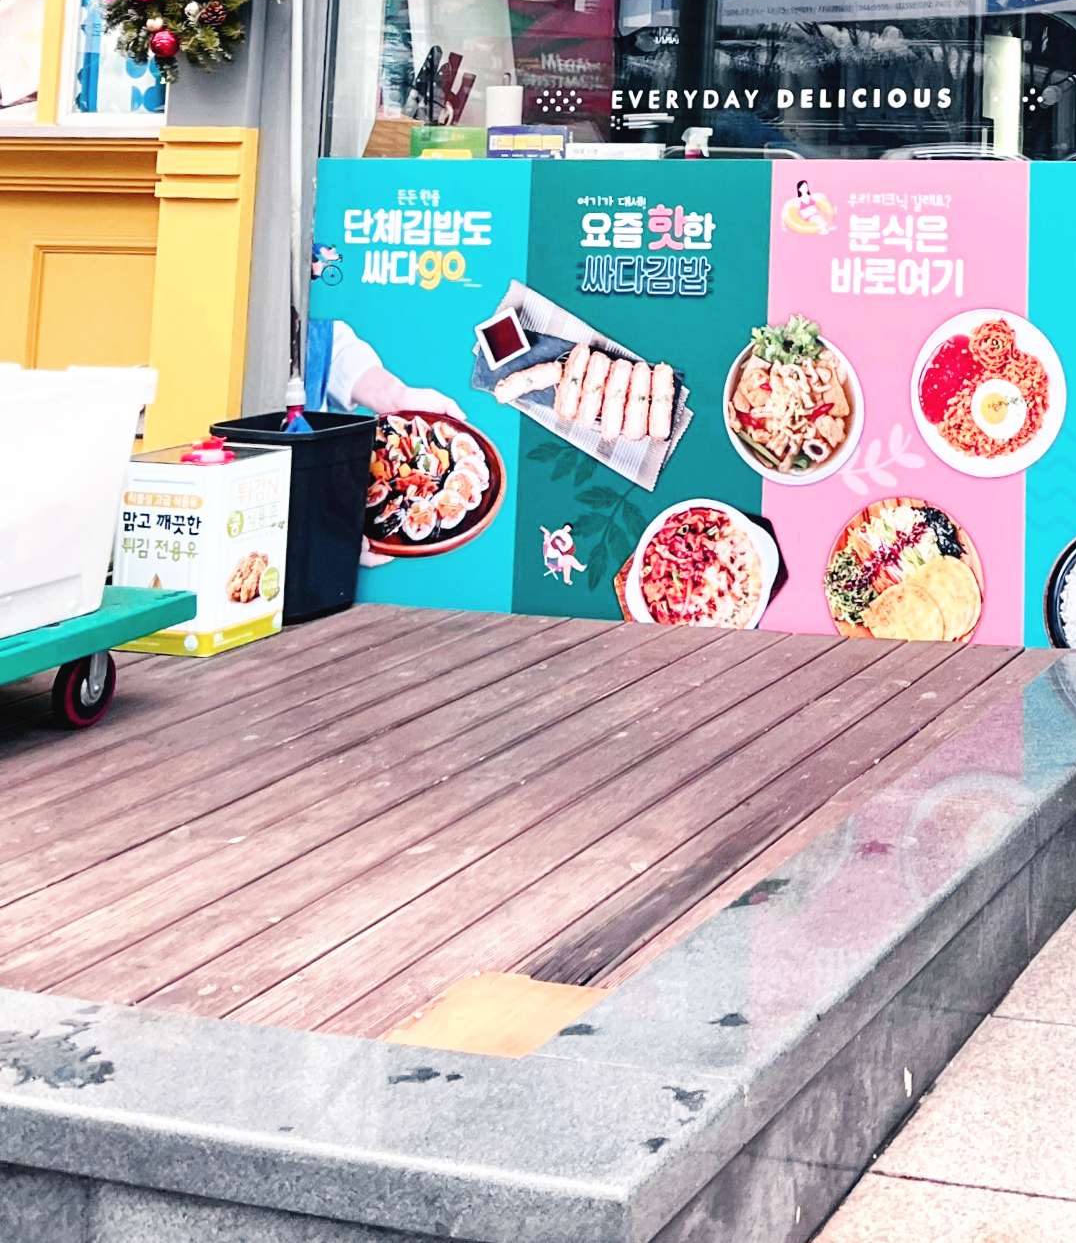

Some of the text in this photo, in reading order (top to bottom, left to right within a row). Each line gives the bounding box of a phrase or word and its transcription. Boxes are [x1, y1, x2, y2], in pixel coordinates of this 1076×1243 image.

[612, 88, 953, 109] EVERYDAY DELICIOUS
[577, 196, 647, 210] 여기가 대세!
[847, 193, 952, 212] 우리 피크닉 갈래요?
[343, 210, 492, 246] 단체김밥도
[580, 203, 716, 251] 요즘 핫한
[848, 215, 949, 253] 분식은
[362, 250, 467, 291] 싸다go
[580, 254, 712, 296] 싸다김밥
[830, 258, 965, 298] 바로여기
[123, 511, 202, 536] 맑고 깨끗한
[122, 537, 199, 562] 튀김 전용유
